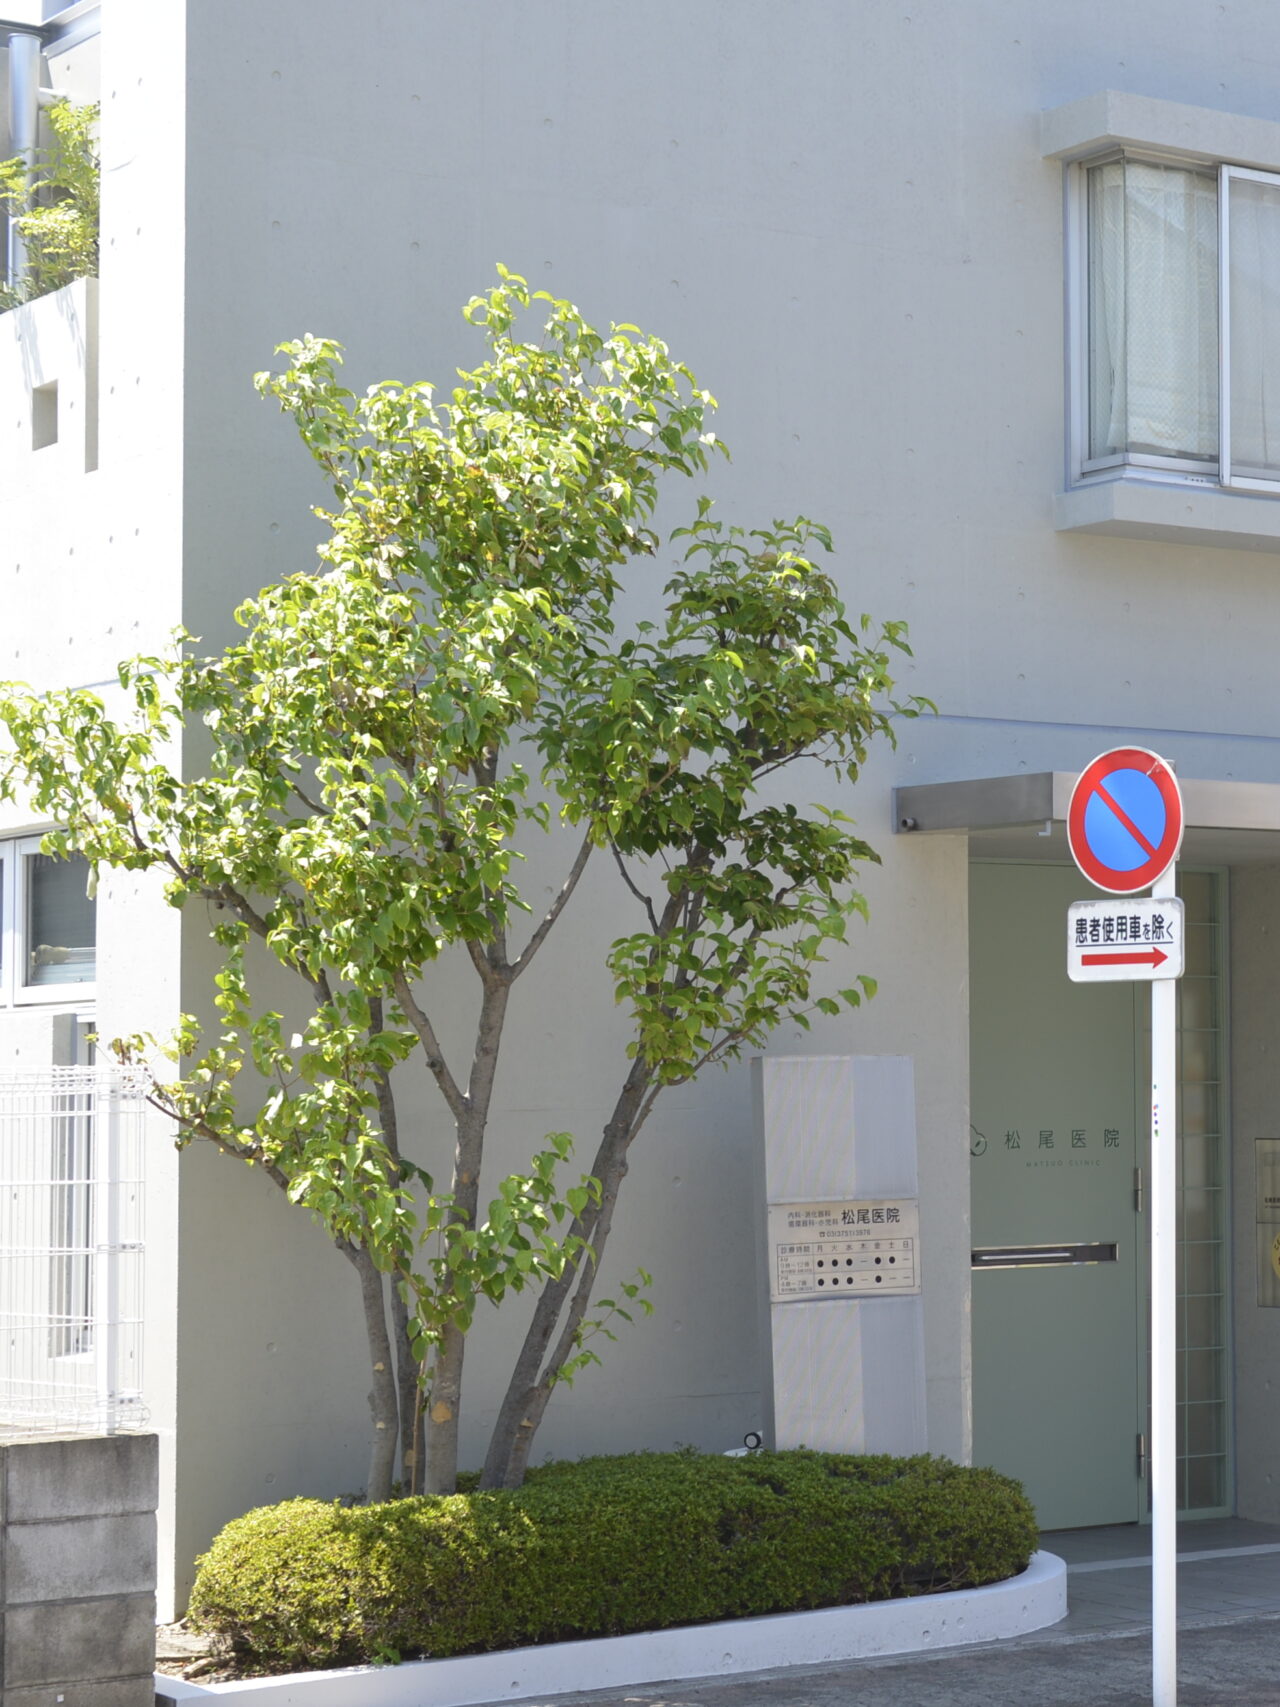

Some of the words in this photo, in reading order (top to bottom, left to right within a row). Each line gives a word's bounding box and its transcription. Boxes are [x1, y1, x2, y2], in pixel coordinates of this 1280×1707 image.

[1075, 914, 1173, 943] 患者使用車を除く
[1004, 1129, 1120, 1150] 松尾医院
[841, 1208, 900, 1225] 松尾医院
[903, 1240, 909, 1248] 日
